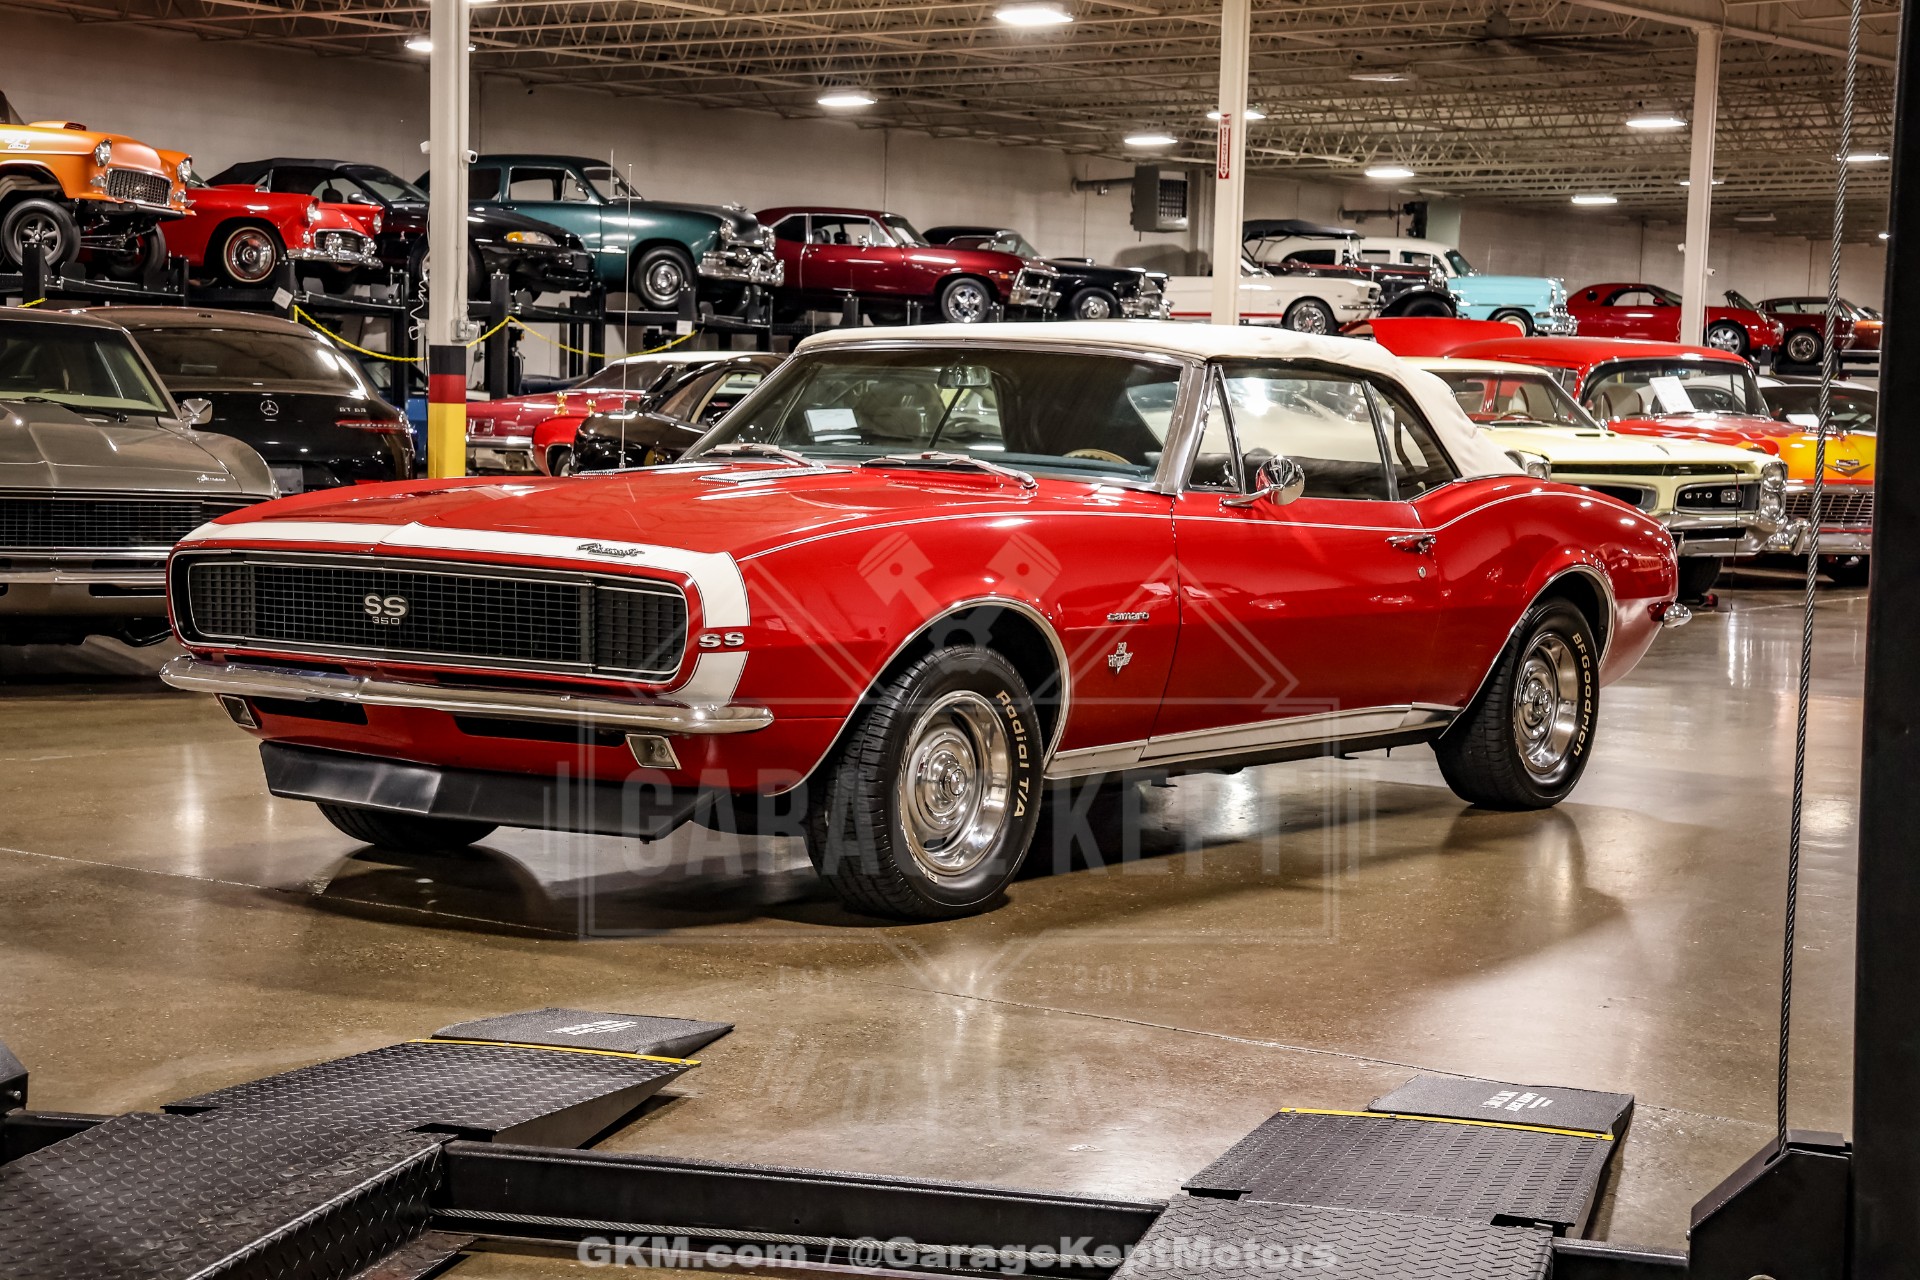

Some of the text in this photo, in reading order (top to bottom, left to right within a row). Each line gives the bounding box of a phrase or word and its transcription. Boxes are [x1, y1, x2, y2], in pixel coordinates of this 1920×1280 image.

[364, 595, 407, 617] SS
[372, 616, 400, 625] 350
[699, 631, 745, 648] SS
[1571, 632, 1592, 757] BFGoodrich
[995, 690, 1030, 818] Radial T/A
